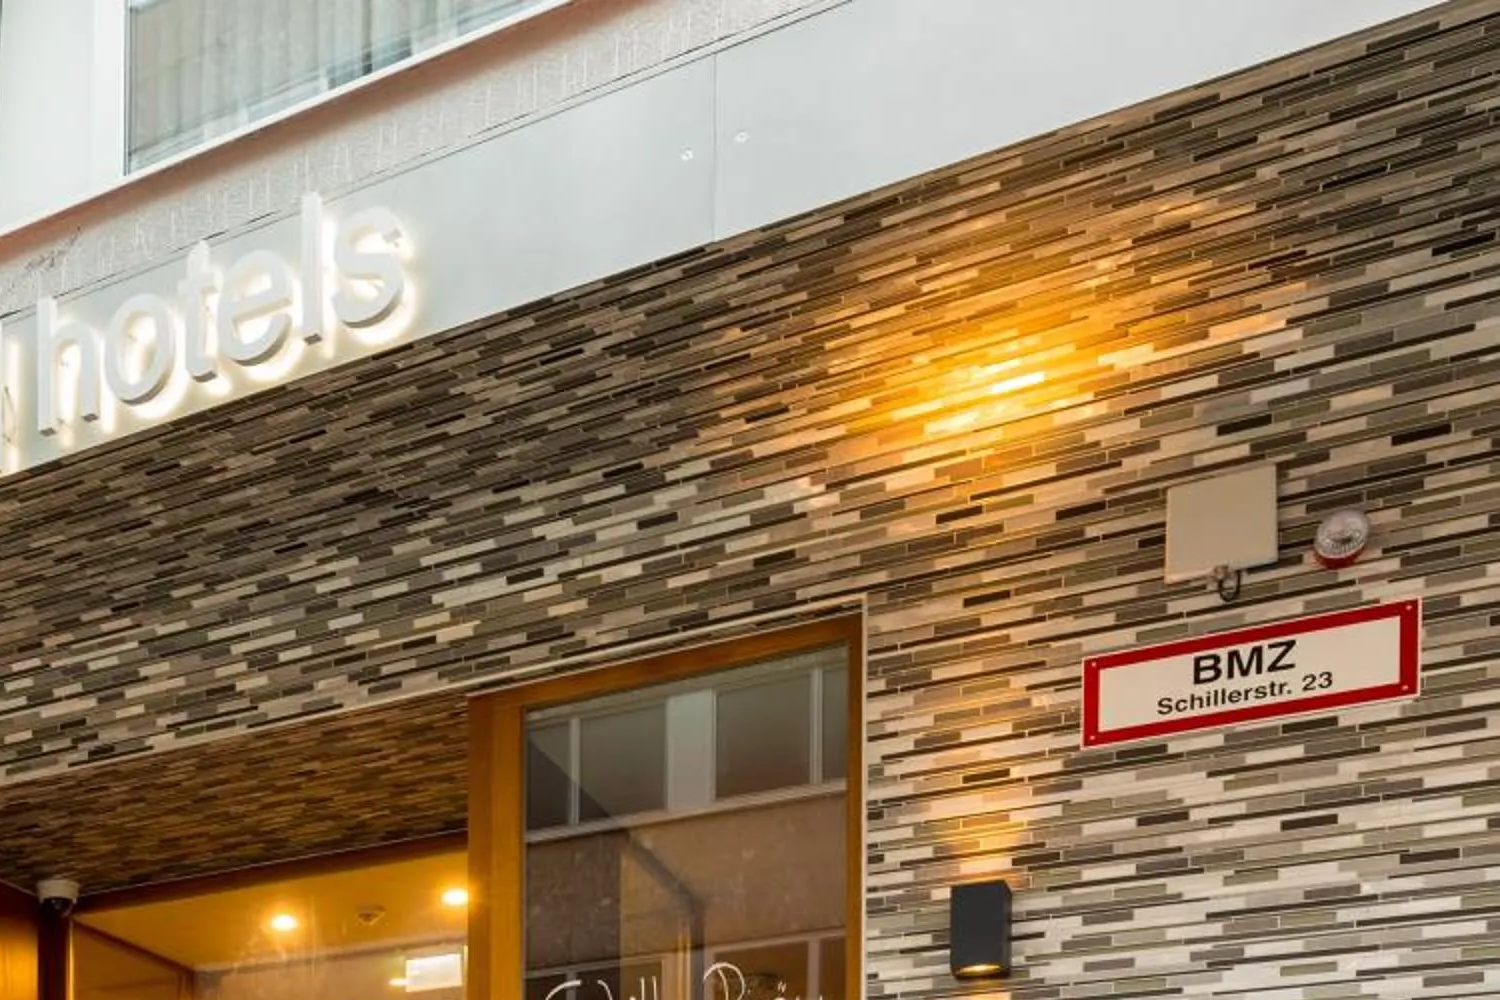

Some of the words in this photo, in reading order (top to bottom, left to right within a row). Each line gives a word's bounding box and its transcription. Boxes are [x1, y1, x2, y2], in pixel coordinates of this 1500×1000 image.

[37, 192, 406, 437] hotels
[1193, 640, 1297, 685] BMZ
[1156, 679, 1293, 716] Schillerstr.
[1302, 671, 1334, 692] 23
